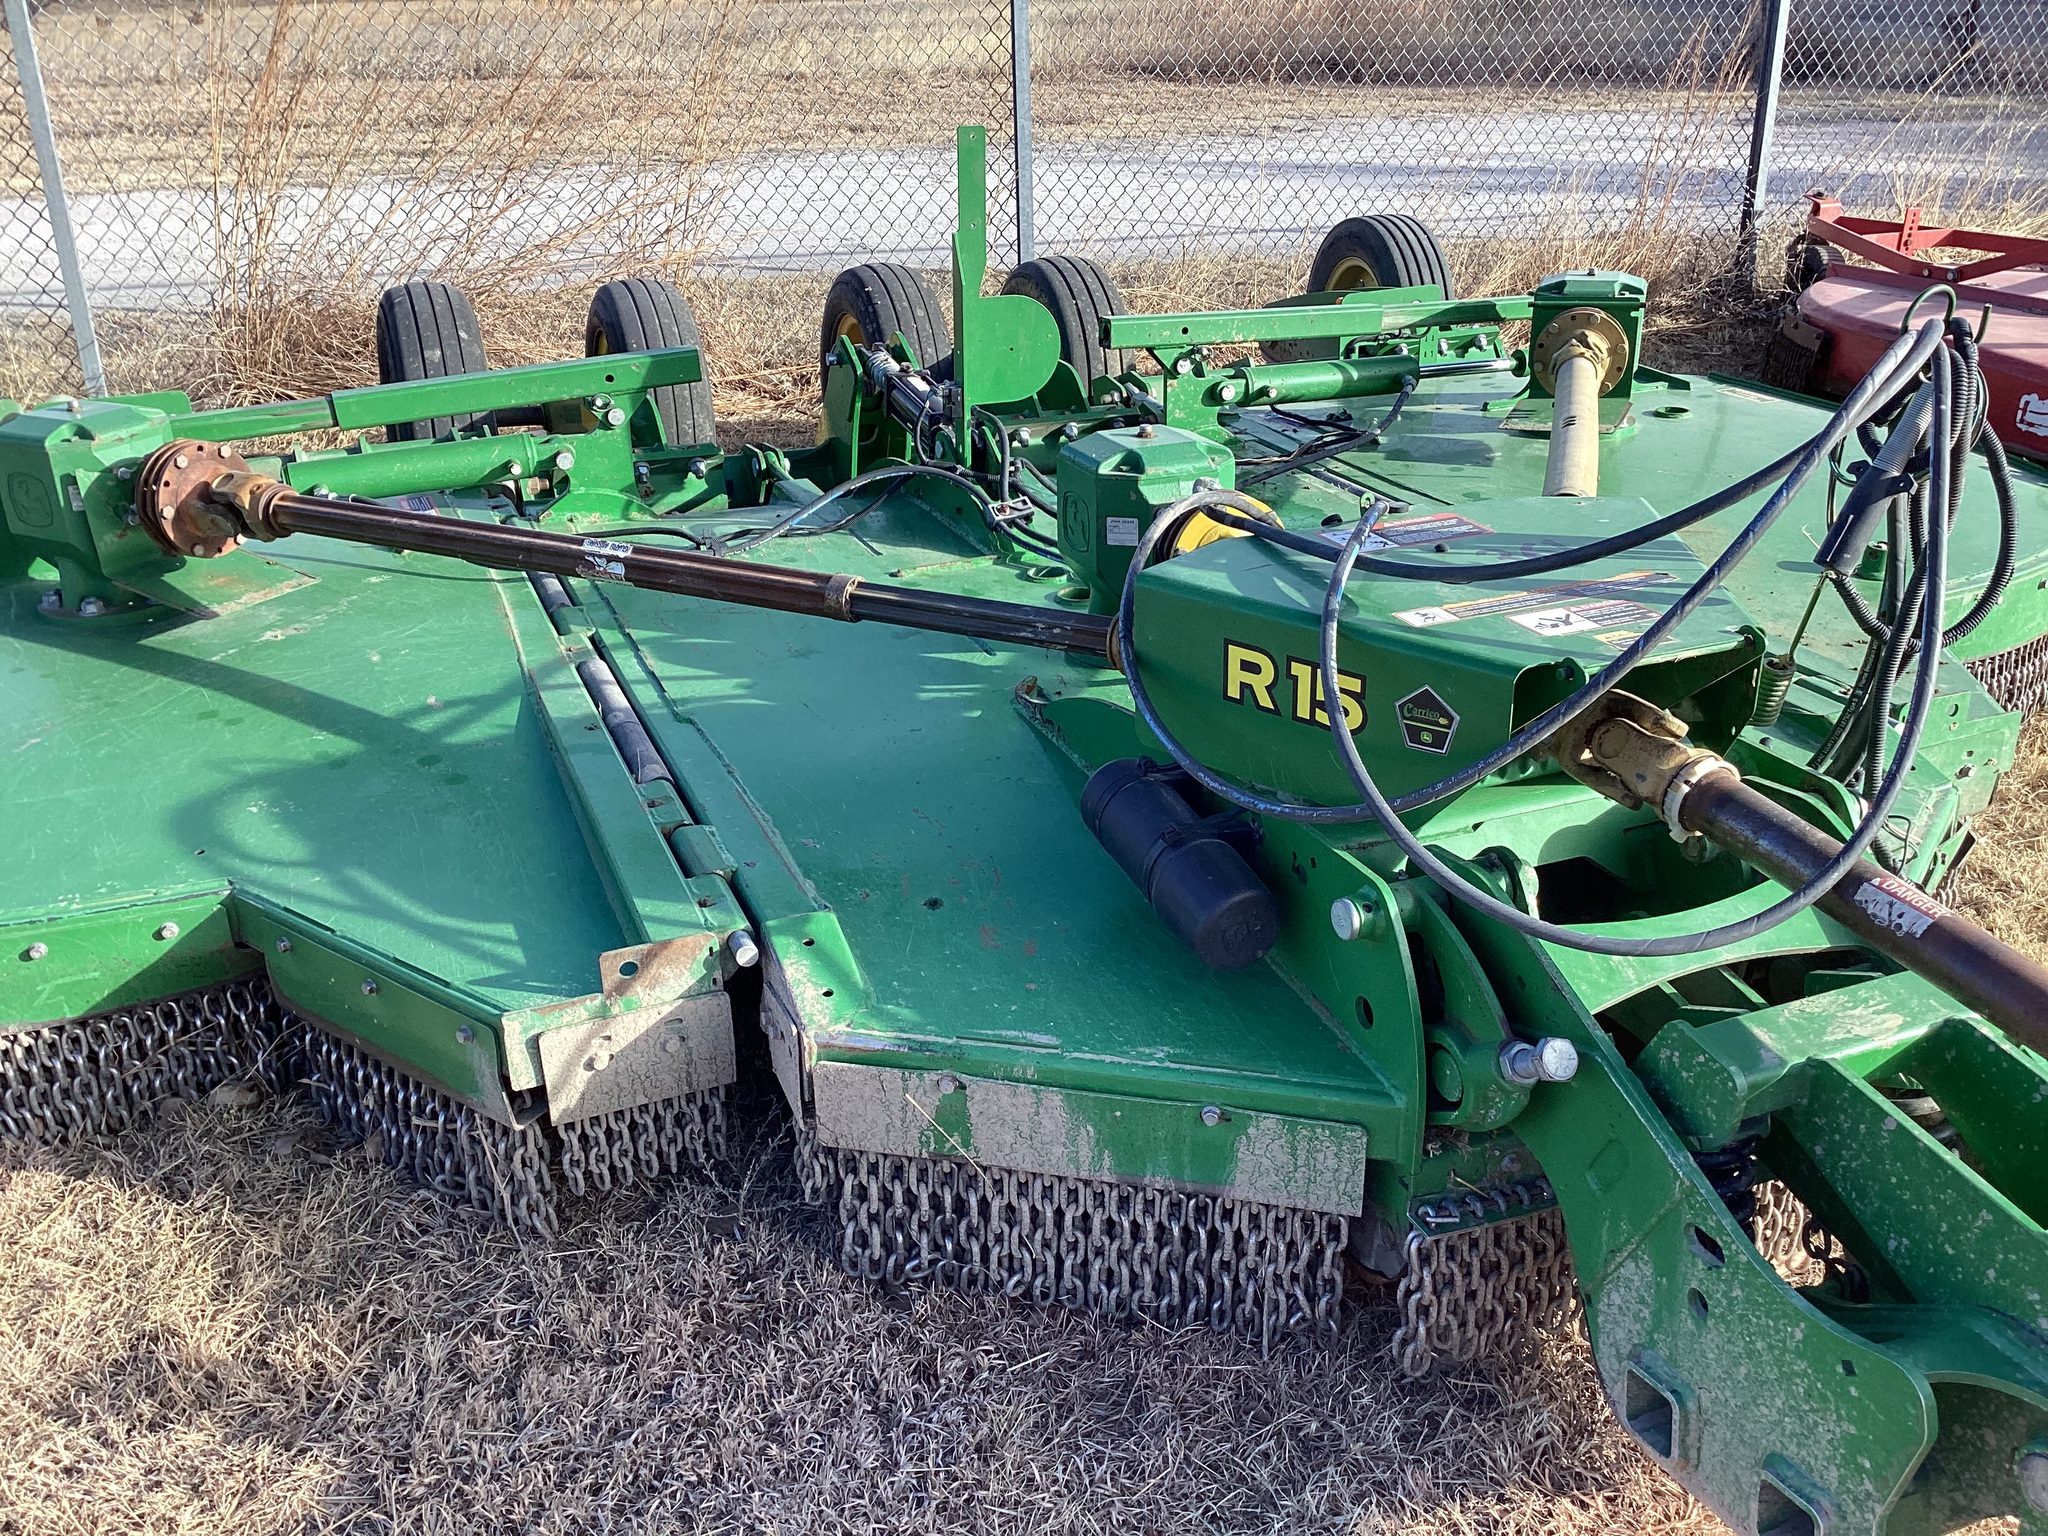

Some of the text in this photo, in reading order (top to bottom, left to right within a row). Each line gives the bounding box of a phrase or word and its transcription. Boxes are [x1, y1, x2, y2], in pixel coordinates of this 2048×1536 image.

[1227, 644, 1364, 731] R 15
[1403, 703, 1440, 719] Carrico
[1882, 880, 1947, 918] DANGER
